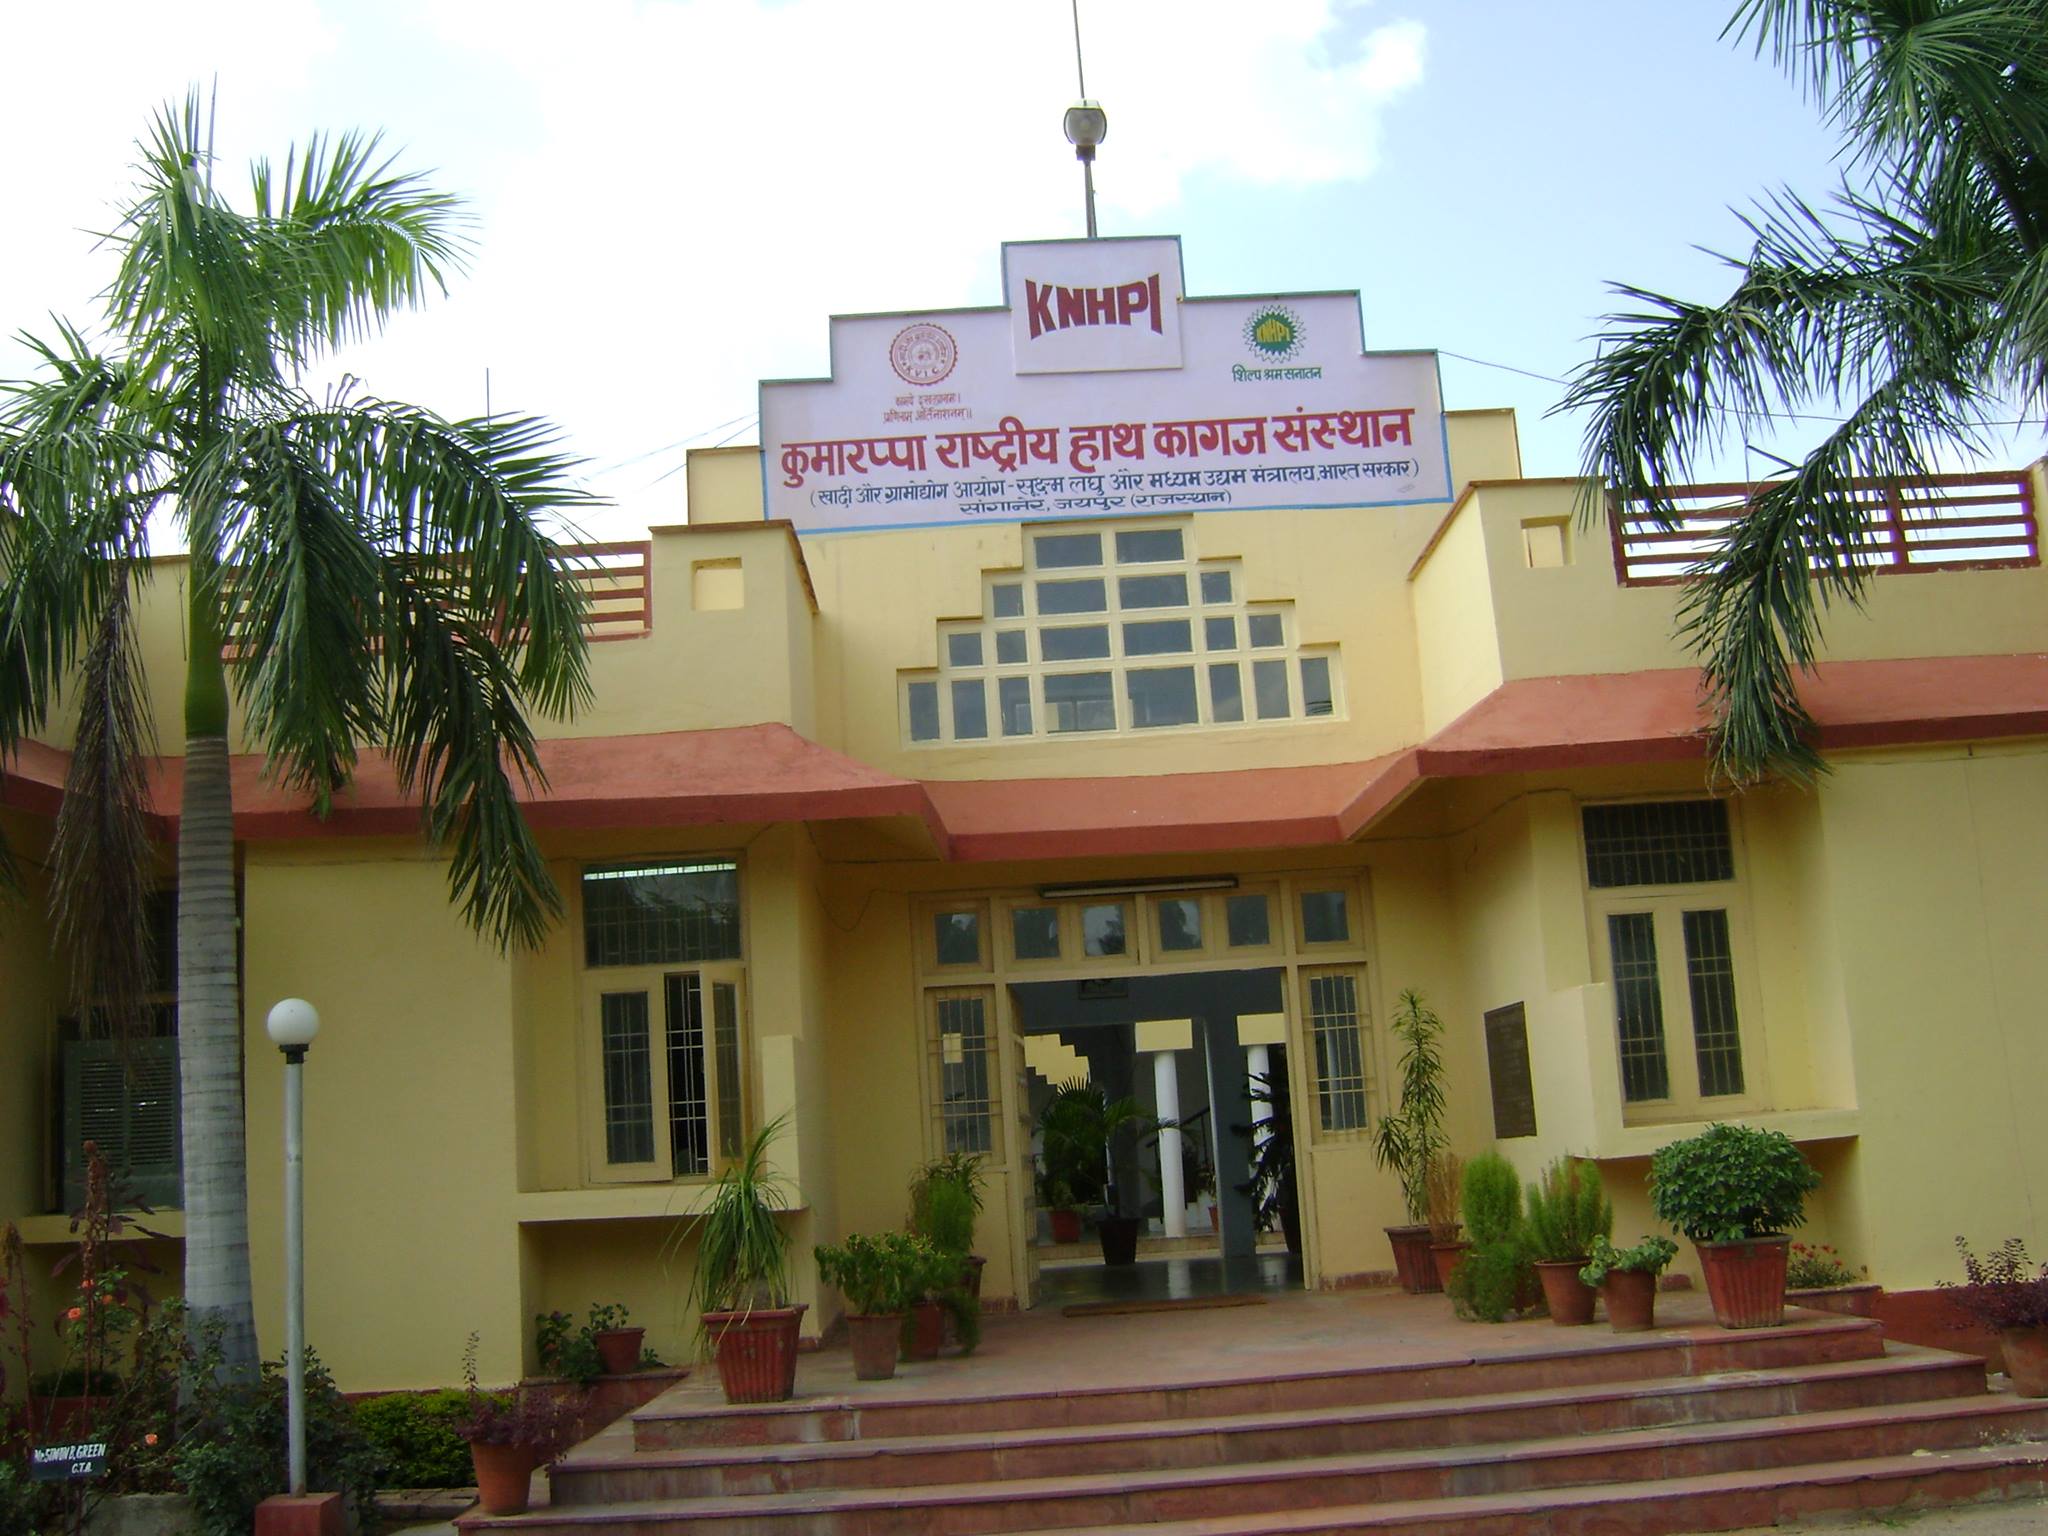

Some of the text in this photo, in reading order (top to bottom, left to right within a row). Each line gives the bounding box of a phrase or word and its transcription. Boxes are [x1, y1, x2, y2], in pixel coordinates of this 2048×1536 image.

[1025, 272, 1163, 342] KNHPI
[781, 406, 1415, 489] कुमारप्पा राष्ट्रीय हाथ कागज संस्थान
[856, 482, 883, 504] और
[885, 479, 949, 504] ग्रामोद्योग
[1068, 473, 1105, 496] लघु
[1109, 468, 1144, 491] और
[1147, 470, 1201, 488] मध्यम
[1204, 468, 1247, 486] उद्यम
[1054, 495, 1126, 511] जयपुर
